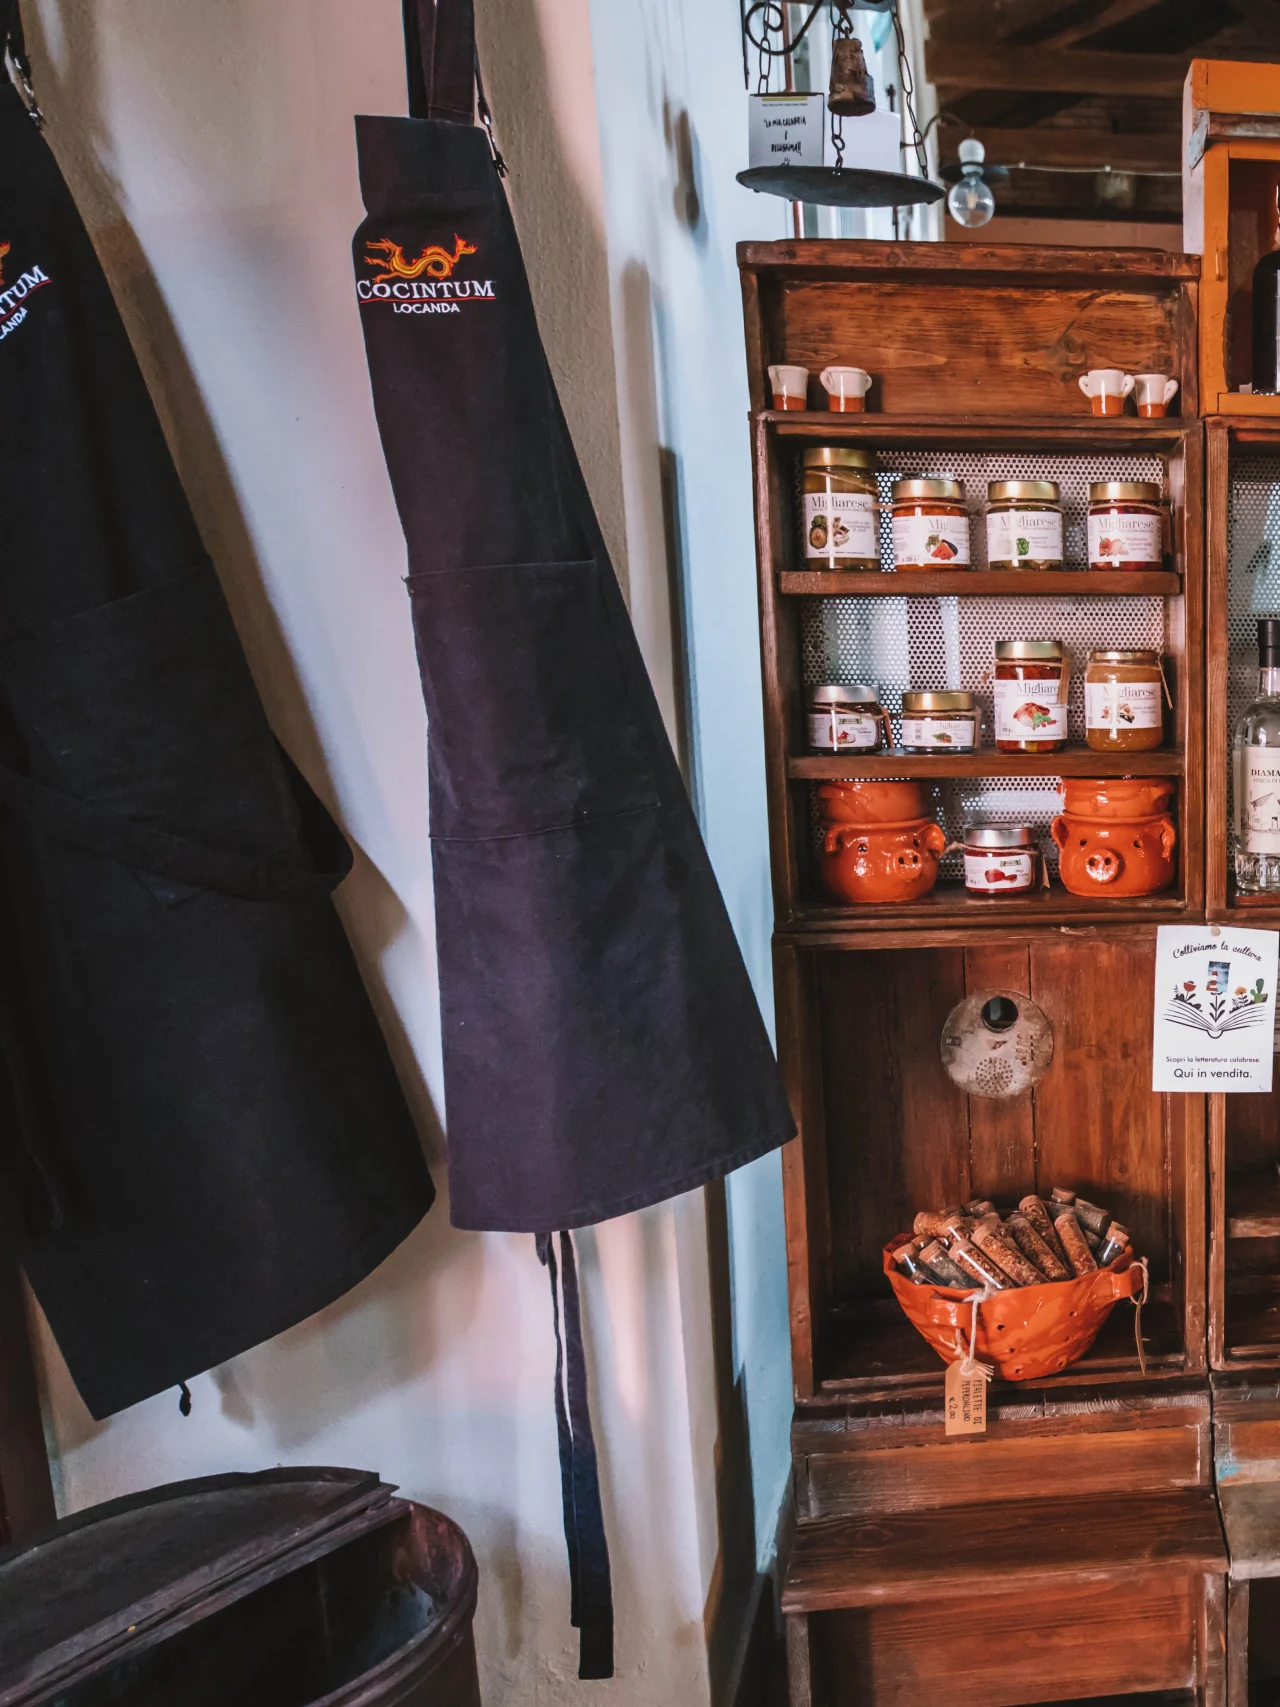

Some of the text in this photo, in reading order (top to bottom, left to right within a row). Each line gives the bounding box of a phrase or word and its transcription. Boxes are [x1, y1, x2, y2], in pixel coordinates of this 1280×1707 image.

[782, 116, 807, 127] CALABRIA
[357, 280, 496, 299] COCINTUM
[393, 303, 461, 313] LOCANDA
[1000, 515, 1057, 528] Mgliarese
[1016, 682, 1060, 694] Migliare
[1103, 685, 1157, 698] Mgliarese
[1172, 941, 1262, 962] Coltiviamo la cultura
[1166, 1056, 1186, 1065] Scopri
[1173, 1068, 1253, 1078] Qui in vendita.
[972, 1416, 983, 1425] DI
